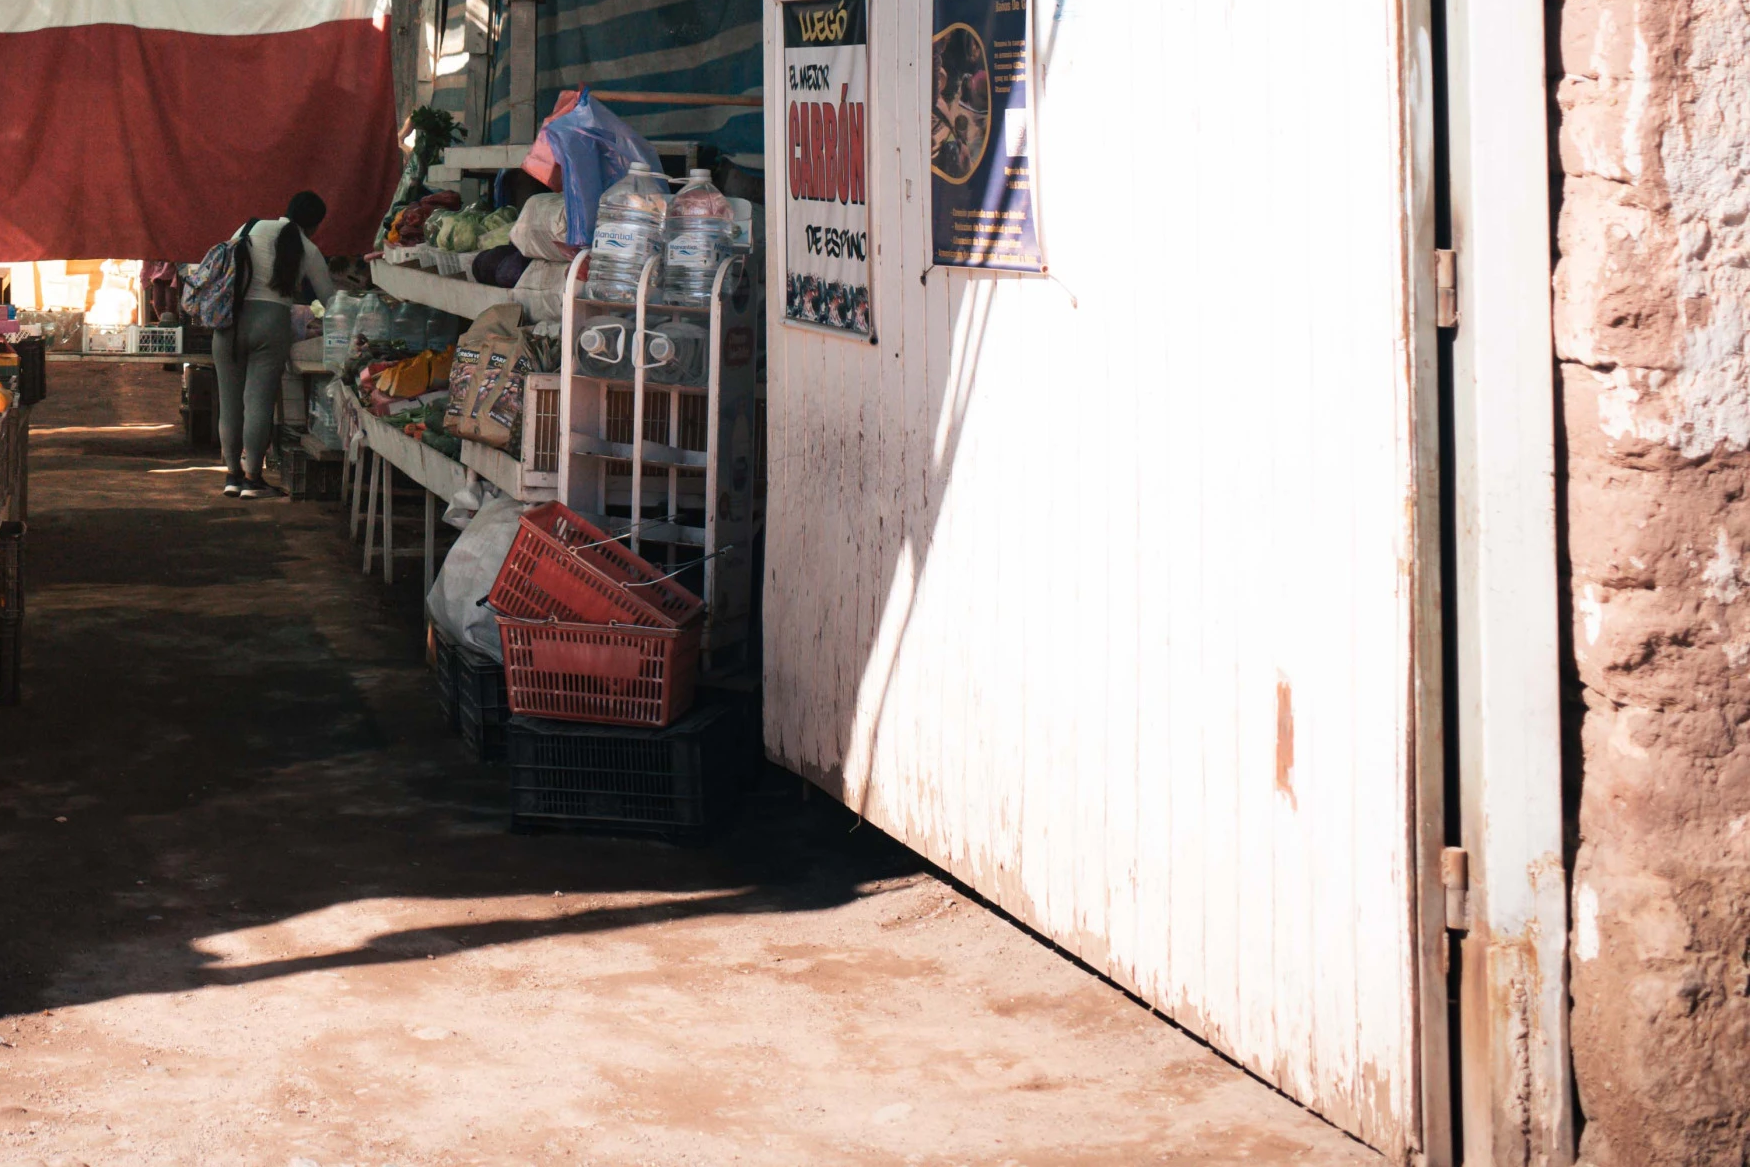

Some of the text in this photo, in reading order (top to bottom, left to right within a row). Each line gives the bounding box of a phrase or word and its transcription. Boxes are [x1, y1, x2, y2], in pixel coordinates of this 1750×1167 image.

[789, 64, 830, 91] EL MEJOR
[788, 83, 865, 205] CARBÓN
[805, 224, 866, 262] DE ESPINO
